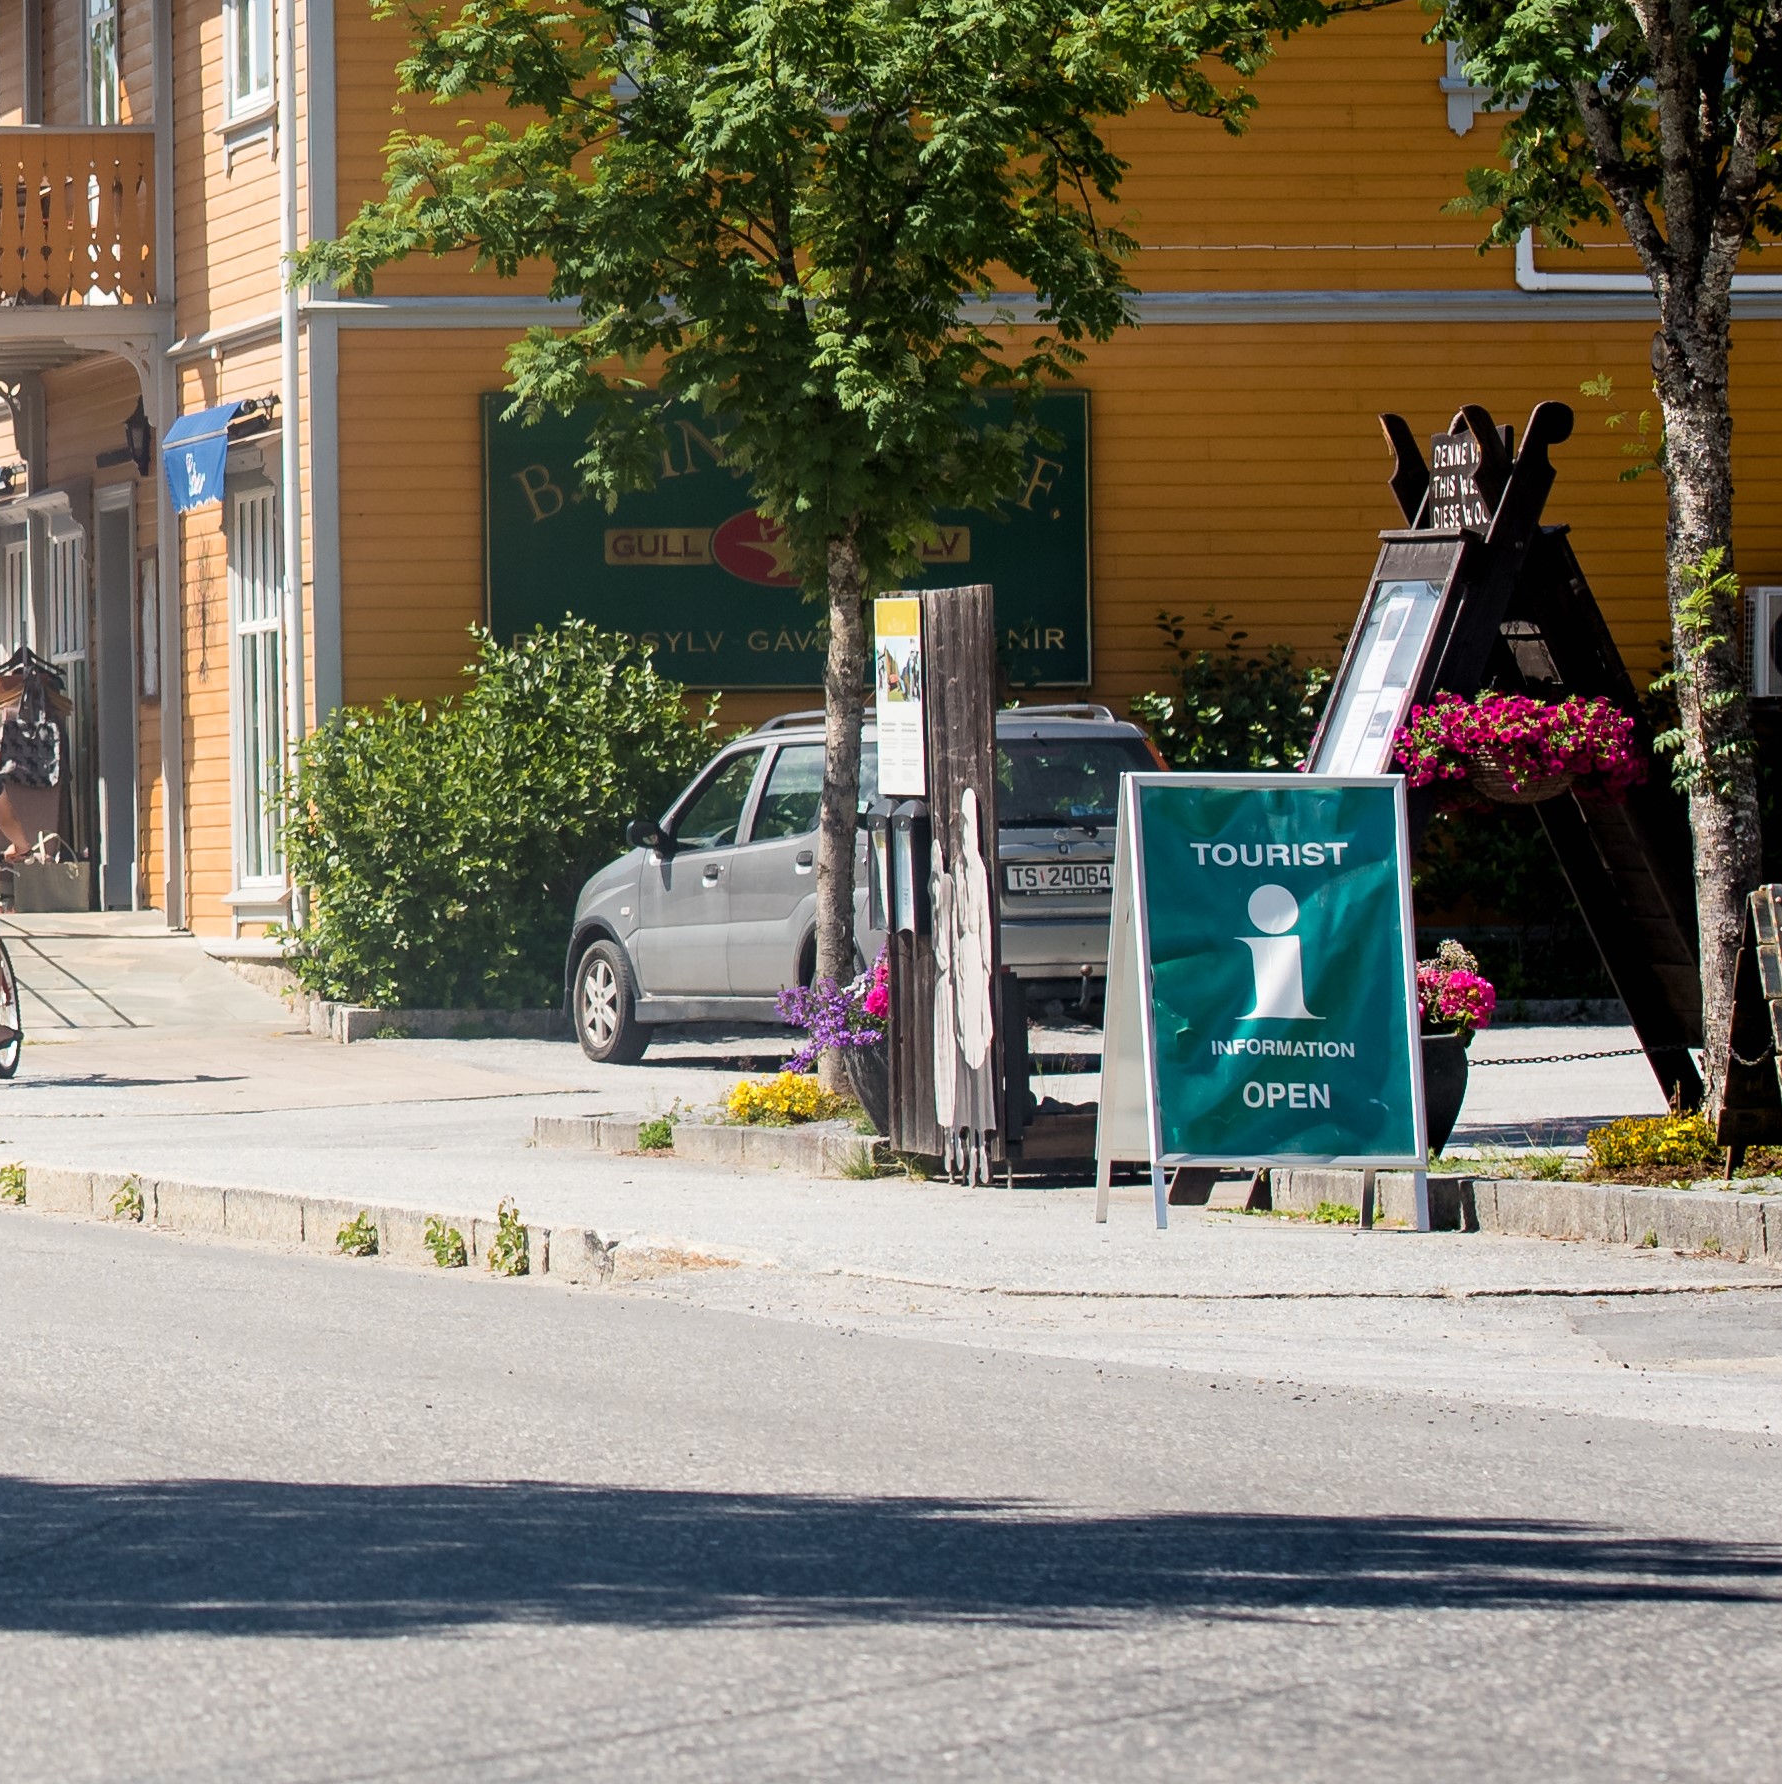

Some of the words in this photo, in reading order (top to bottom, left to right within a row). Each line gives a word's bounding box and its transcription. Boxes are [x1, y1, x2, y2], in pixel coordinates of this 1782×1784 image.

[1434, 442, 1468, 469] DENNE
[1433, 474, 1456, 499] THIS
[1433, 503, 1461, 529] DIESE
[612, 534, 703, 558] GULL
[1190, 842, 1348, 867] TOURIST
[1012, 868, 1037, 887] TS
[1048, 866, 1111, 886] 24064
[1211, 1039, 1355, 1059] INFORMATION
[1243, 1081, 1331, 1109] OPEN
